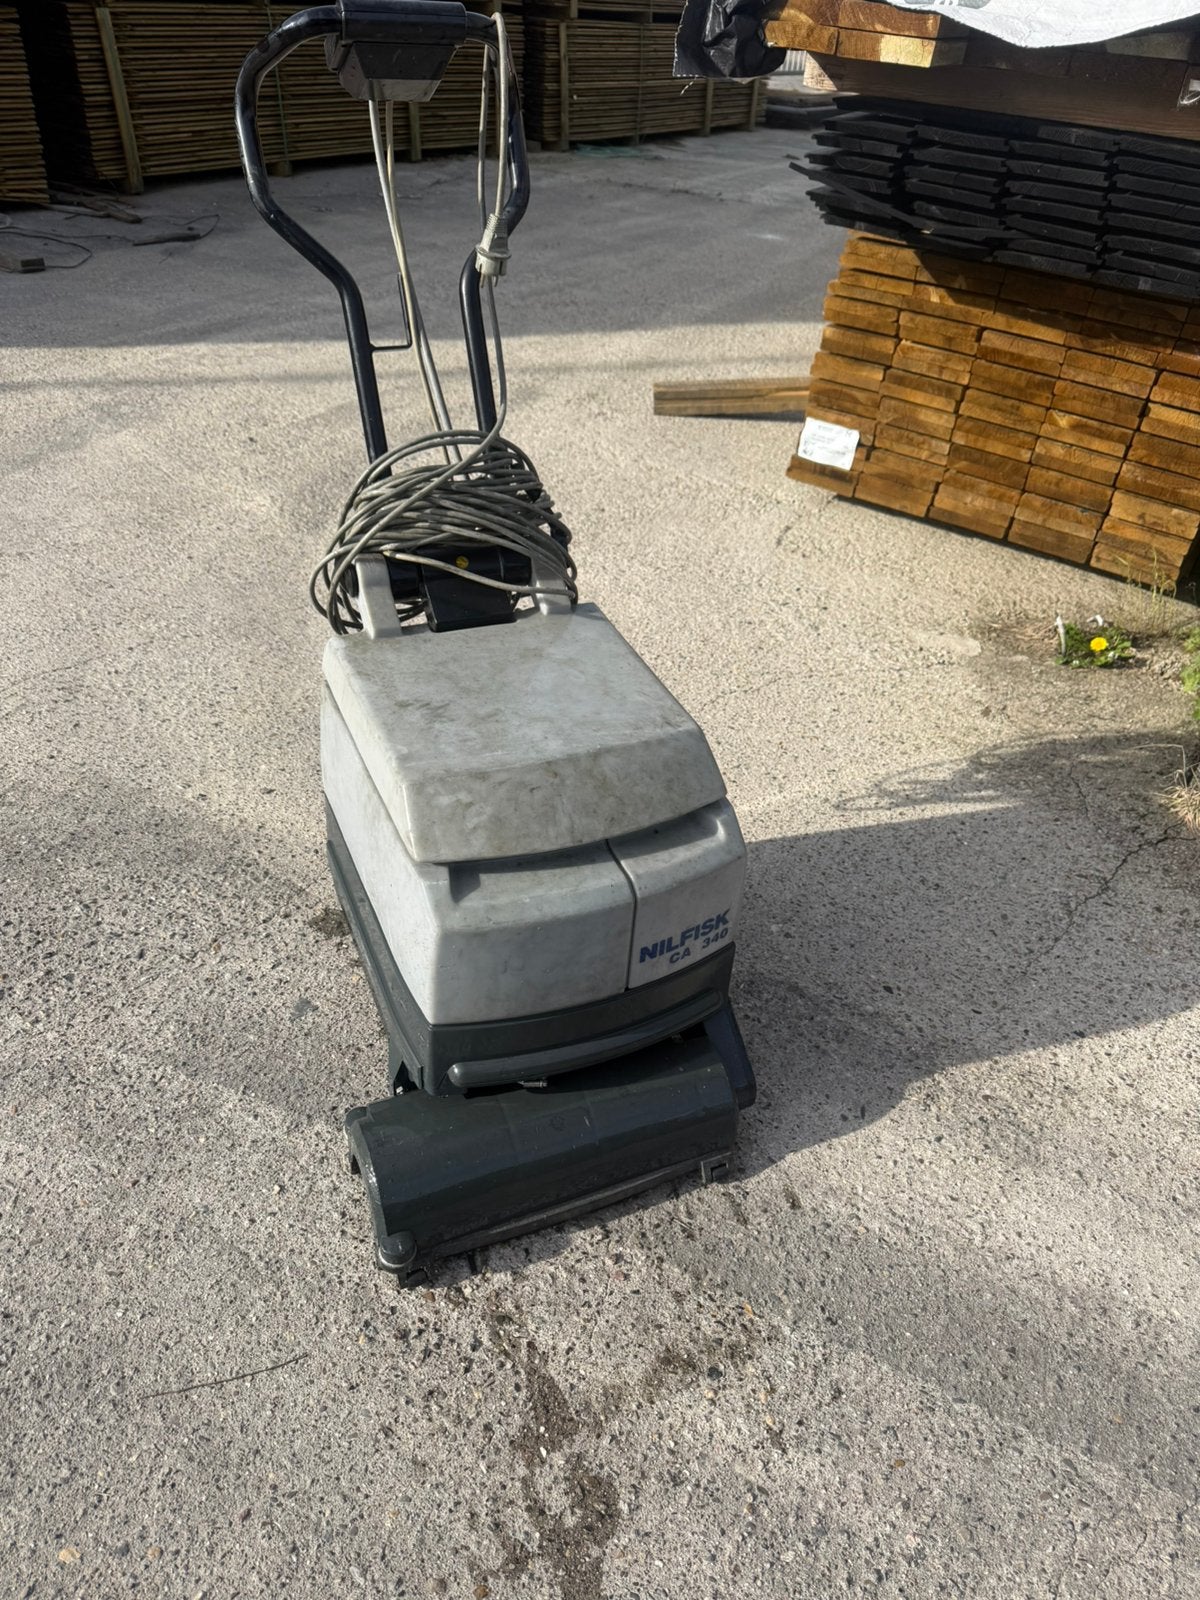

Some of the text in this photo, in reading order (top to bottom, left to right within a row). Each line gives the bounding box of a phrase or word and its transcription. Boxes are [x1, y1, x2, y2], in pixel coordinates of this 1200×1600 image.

[639, 908, 731, 963] NILFISK
[669, 927, 729, 964] CA 340
